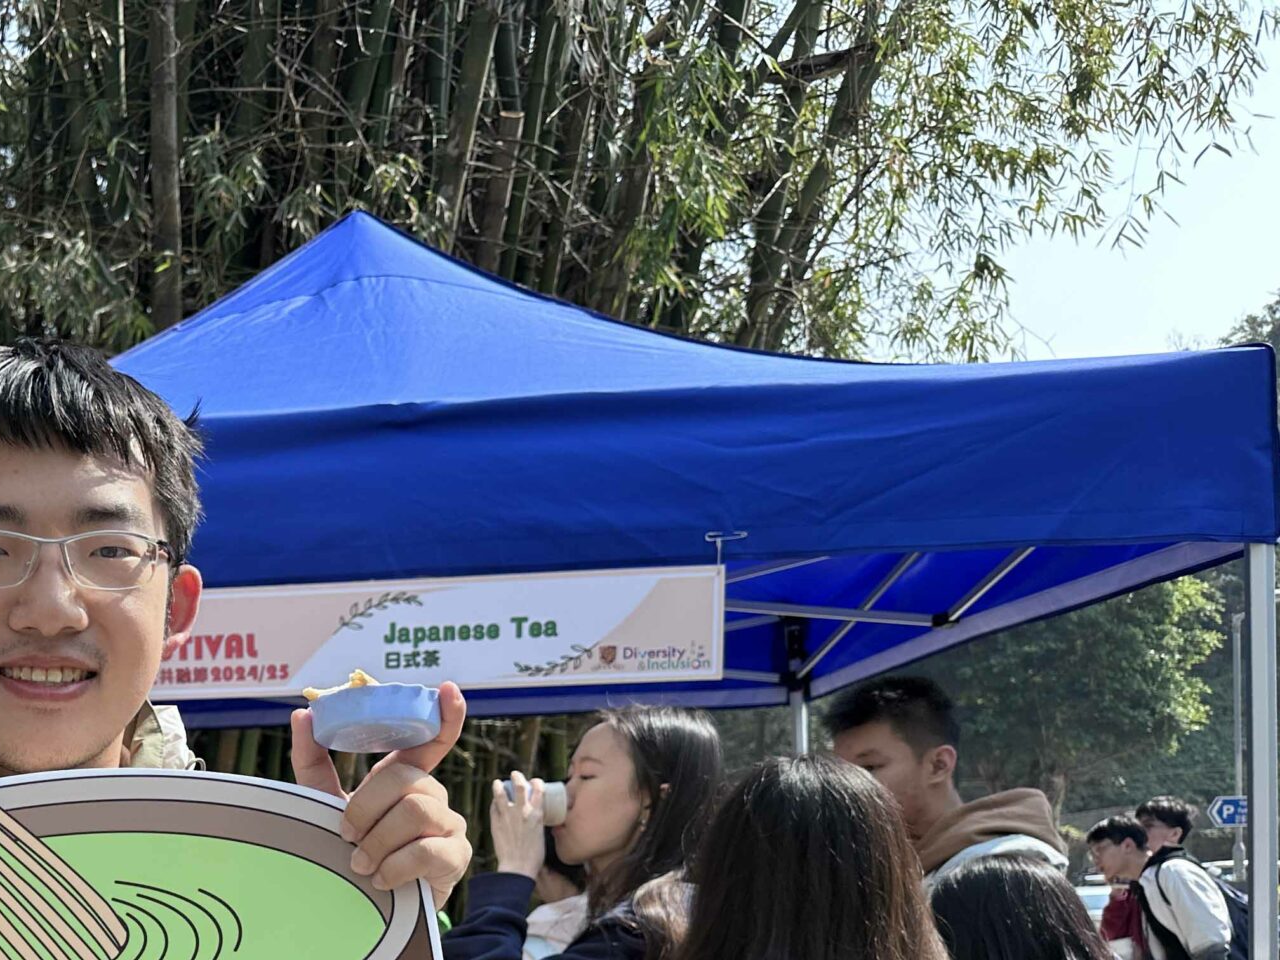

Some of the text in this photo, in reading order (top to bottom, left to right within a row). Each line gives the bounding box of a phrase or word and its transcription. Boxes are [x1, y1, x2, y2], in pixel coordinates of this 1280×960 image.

[384, 616, 558, 647] Japanese Tea
[161, 632, 259, 662] TIVAL
[623, 646, 686, 661] Diversity
[384, 650, 440, 669] 日式茶
[1223, 804, 1235, 819] P
